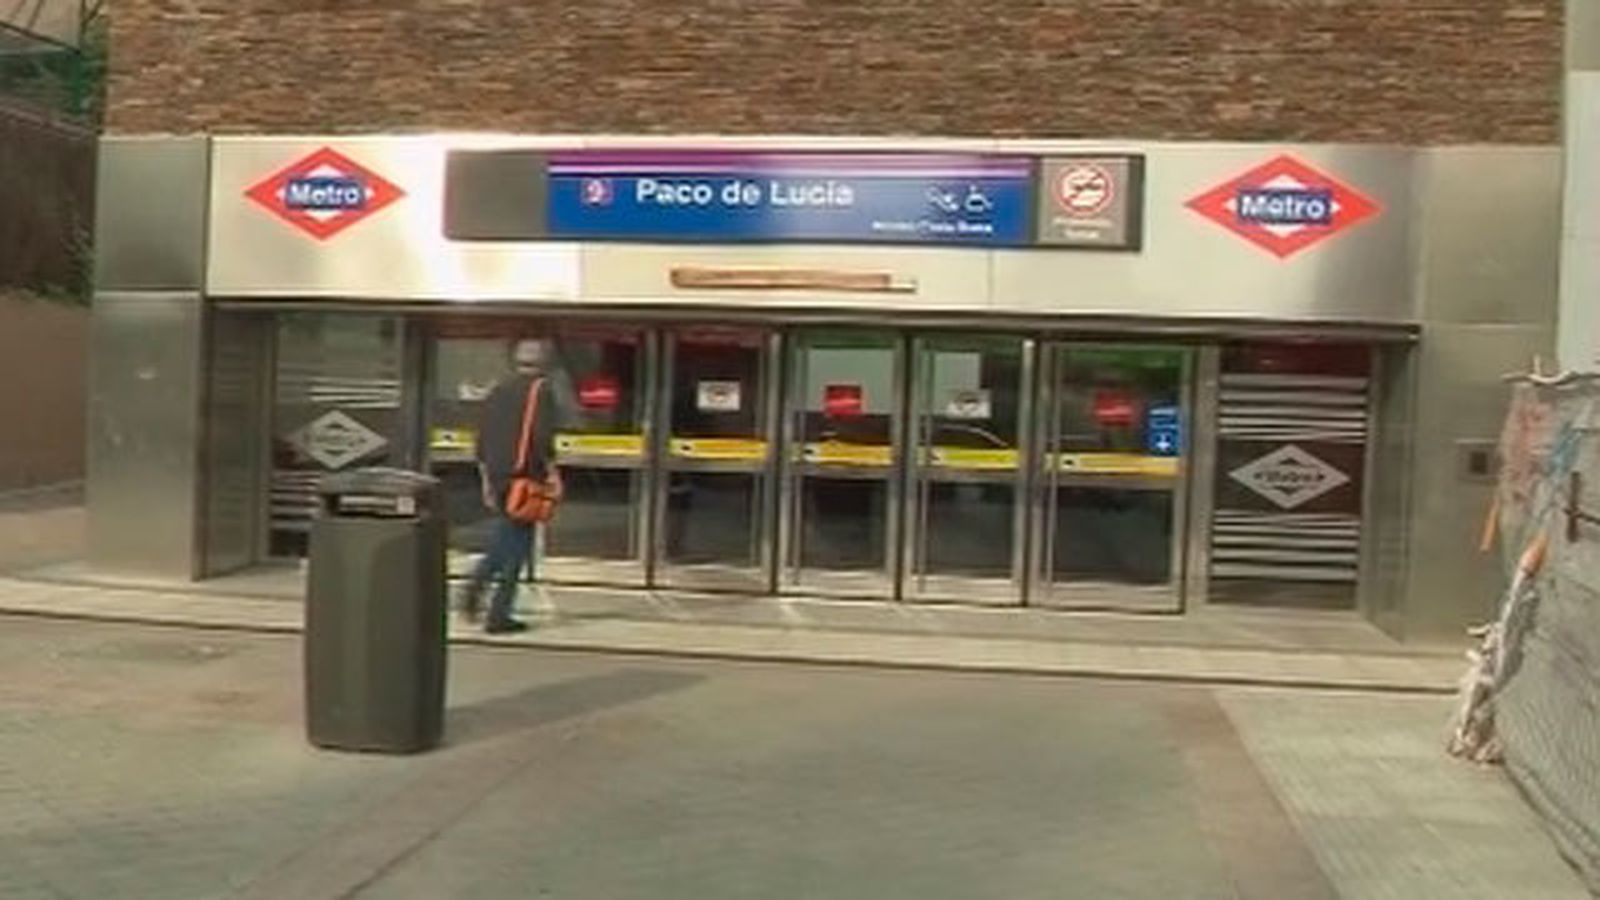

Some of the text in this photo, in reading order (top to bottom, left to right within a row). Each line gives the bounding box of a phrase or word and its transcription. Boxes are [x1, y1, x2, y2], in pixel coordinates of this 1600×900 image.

[288, 183, 360, 205] Metro
[636, 179, 712, 205] Paco
[721, 181, 760, 205] de
[1240, 195, 1326, 219] Metro
